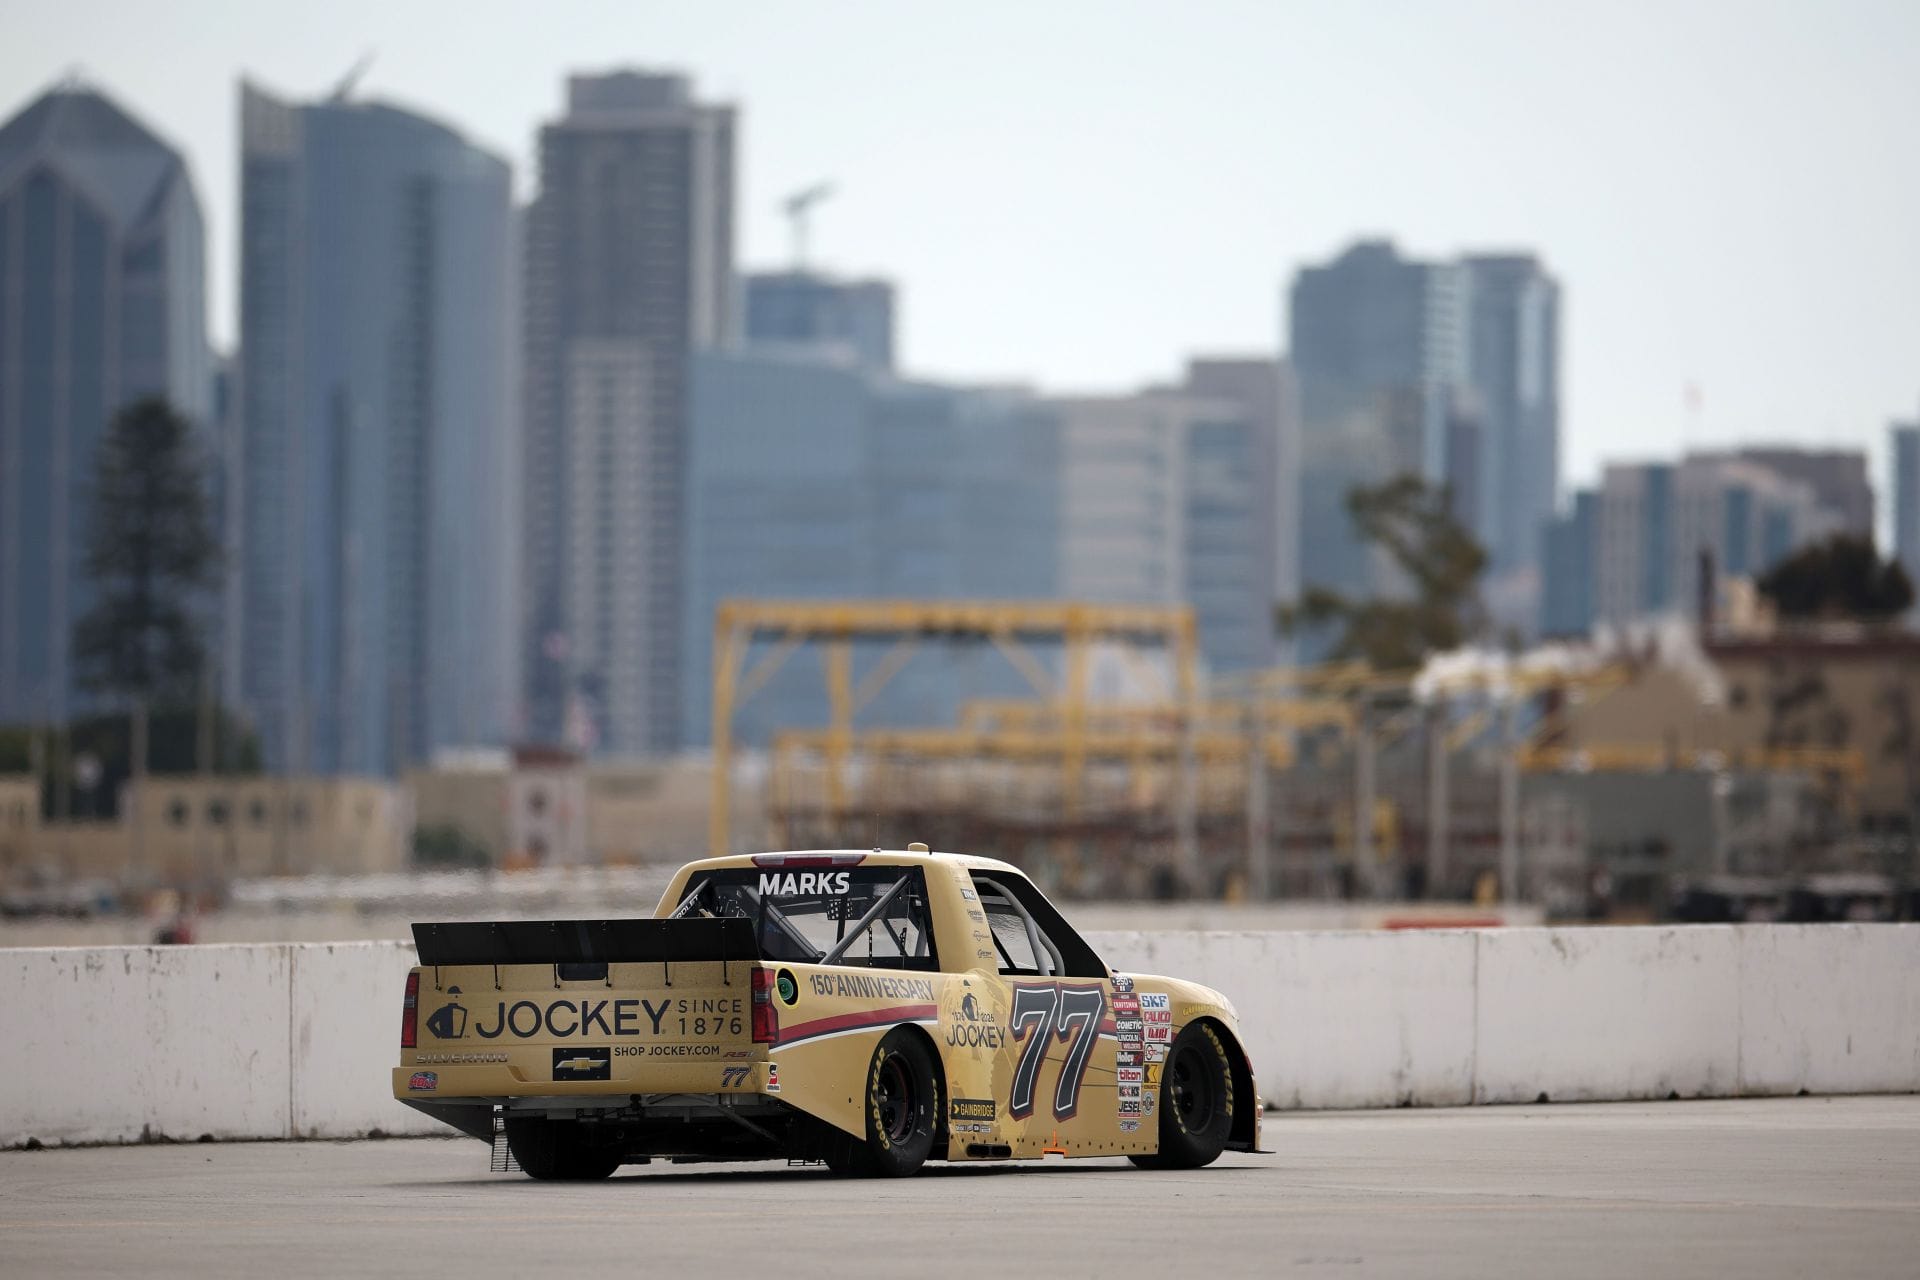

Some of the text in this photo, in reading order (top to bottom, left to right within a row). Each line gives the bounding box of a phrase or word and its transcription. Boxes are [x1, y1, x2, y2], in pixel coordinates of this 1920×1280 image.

[758, 872, 850, 896] MARKS
[837, 975, 936, 1001] ANNIVERSARY
[678, 999, 742, 1014] SINCE
[1141, 995, 1167, 1008] SKF
[475, 999, 672, 1039] JOCKEY
[678, 1017, 742, 1035] 1876
[1116, 1021, 1143, 1030] COMETIC
[946, 1024, 1006, 1049] JOCKEY
[416, 1053, 509, 1064] SILVERADO
[614, 1045, 720, 1056] SHOP JOCKEY.COM
[1008, 980, 1108, 1124] 77
[720, 1066, 751, 1088] 77
[1201, 1023, 1234, 1117] GOODYEAR
[960, 1103, 994, 1118] GAINBRIDGE
[1118, 1100, 1141, 1113] JESEL
